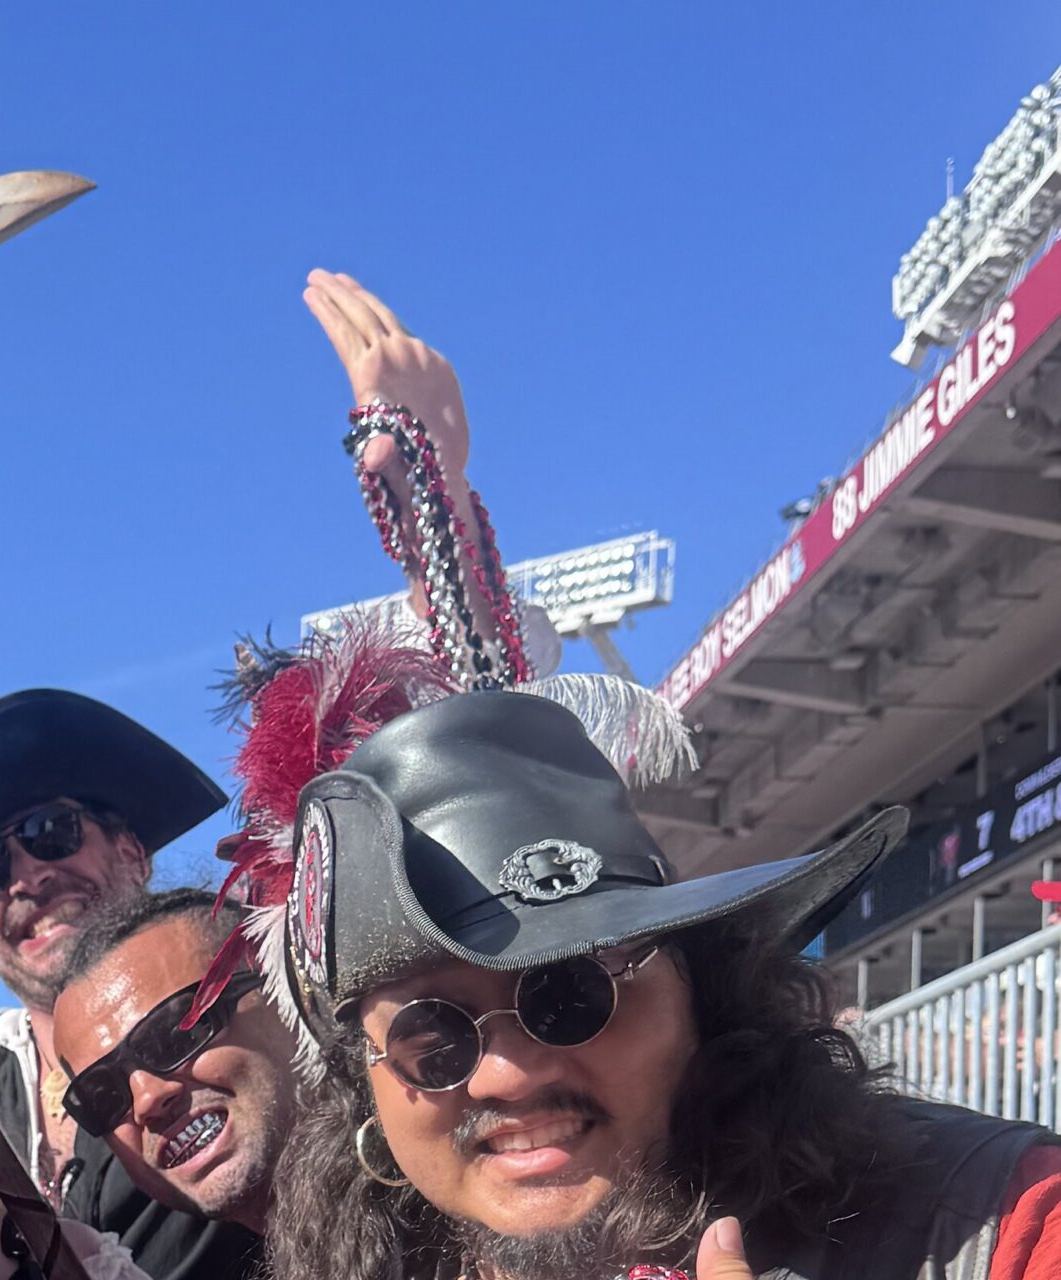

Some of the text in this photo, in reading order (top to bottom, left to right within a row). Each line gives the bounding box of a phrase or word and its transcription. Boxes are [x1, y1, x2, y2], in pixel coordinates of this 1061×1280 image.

[858, 386, 937, 513] JIMMIE
[937, 301, 1016, 426] GILES
[722, 547, 791, 658] SELMON
